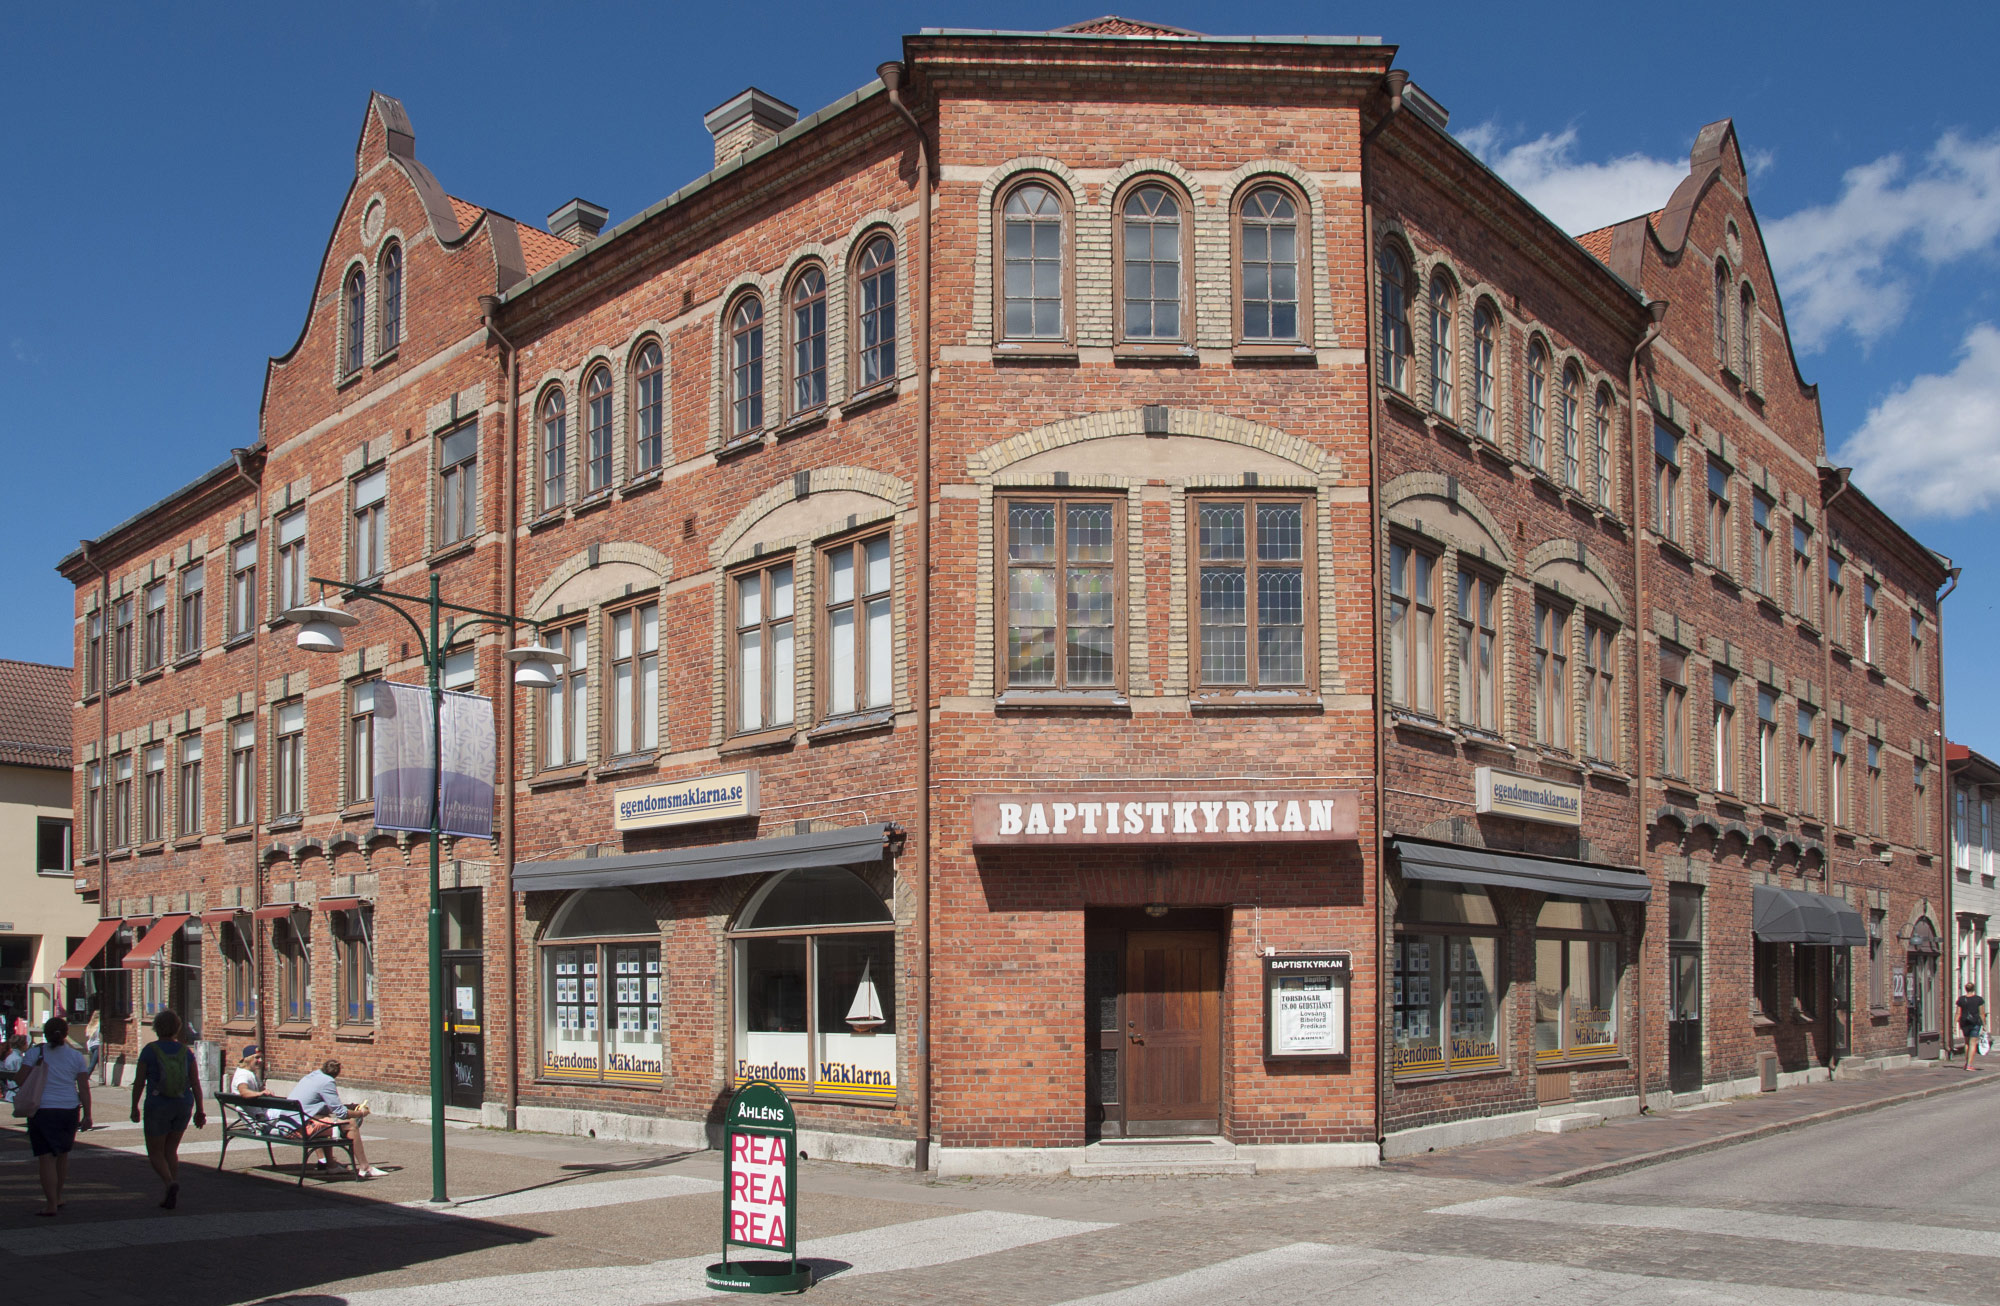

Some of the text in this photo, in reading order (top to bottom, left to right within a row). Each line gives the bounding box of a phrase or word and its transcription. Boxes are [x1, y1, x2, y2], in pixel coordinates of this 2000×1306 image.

[620, 785, 743, 817] egendomsmaklarna.se
[1494, 783, 1578, 811] egendomsmaklarna.se
[999, 800, 1334, 835] BAPTISTKYRKAN
[1272, 960, 1343, 969] BAPTISTKYRKAN
[1281, 994, 1321, 1002] TORSDAGAR
[1893, 974, 1904, 997] 22
[1575, 1027, 1611, 1045] Mäklarna
[547, 1051, 661, 1073] Egendoms Mäklarna
[1452, 1040, 1495, 1059] Mäklarna
[738, 1059, 891, 1086] Egendoms Mäklarna
[737, 1101, 784, 1121] ÅHLÉNS
[731, 1132, 786, 1167] REA
[731, 1170, 786, 1207] REA
[730, 1209, 786, 1248] REA
